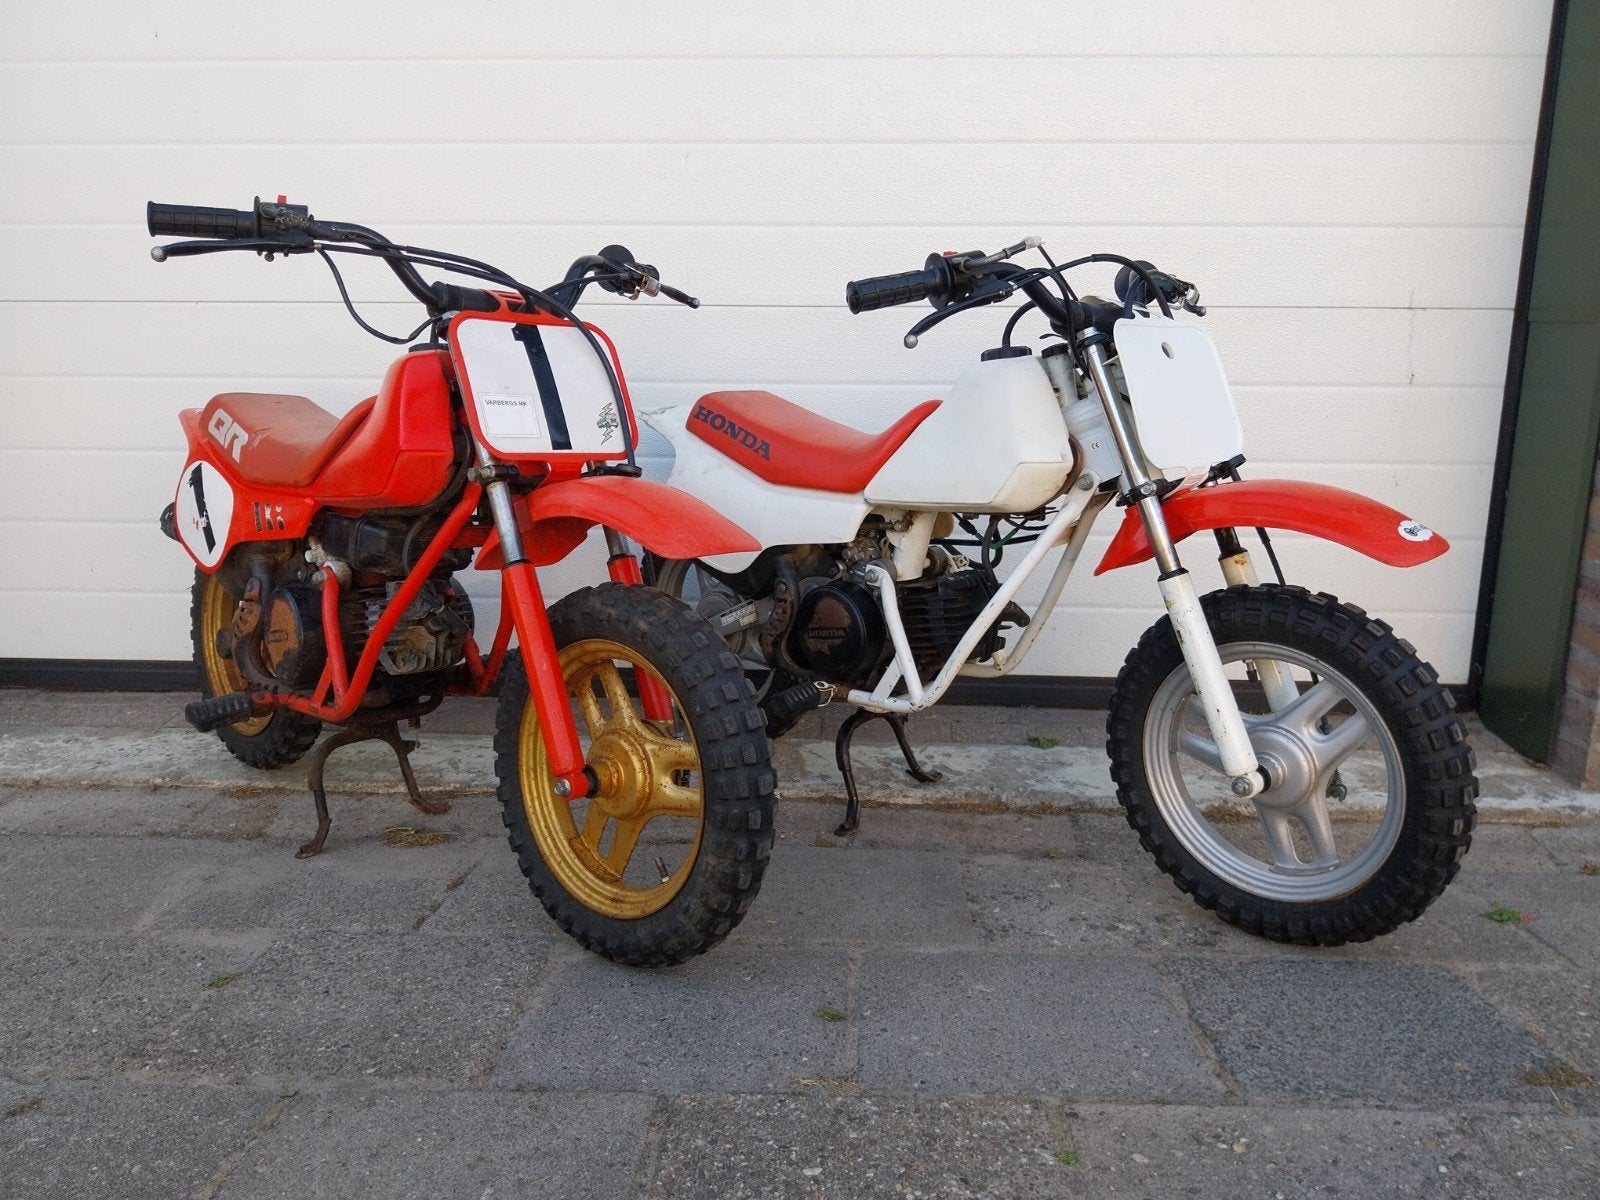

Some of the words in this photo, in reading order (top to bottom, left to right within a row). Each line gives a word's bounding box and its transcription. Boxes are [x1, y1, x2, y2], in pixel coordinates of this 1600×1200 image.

[511, 322, 573, 451] 1
[207, 408, 249, 464] QR
[693, 404, 771, 461] HONDA
[186, 461, 217, 555] 1
